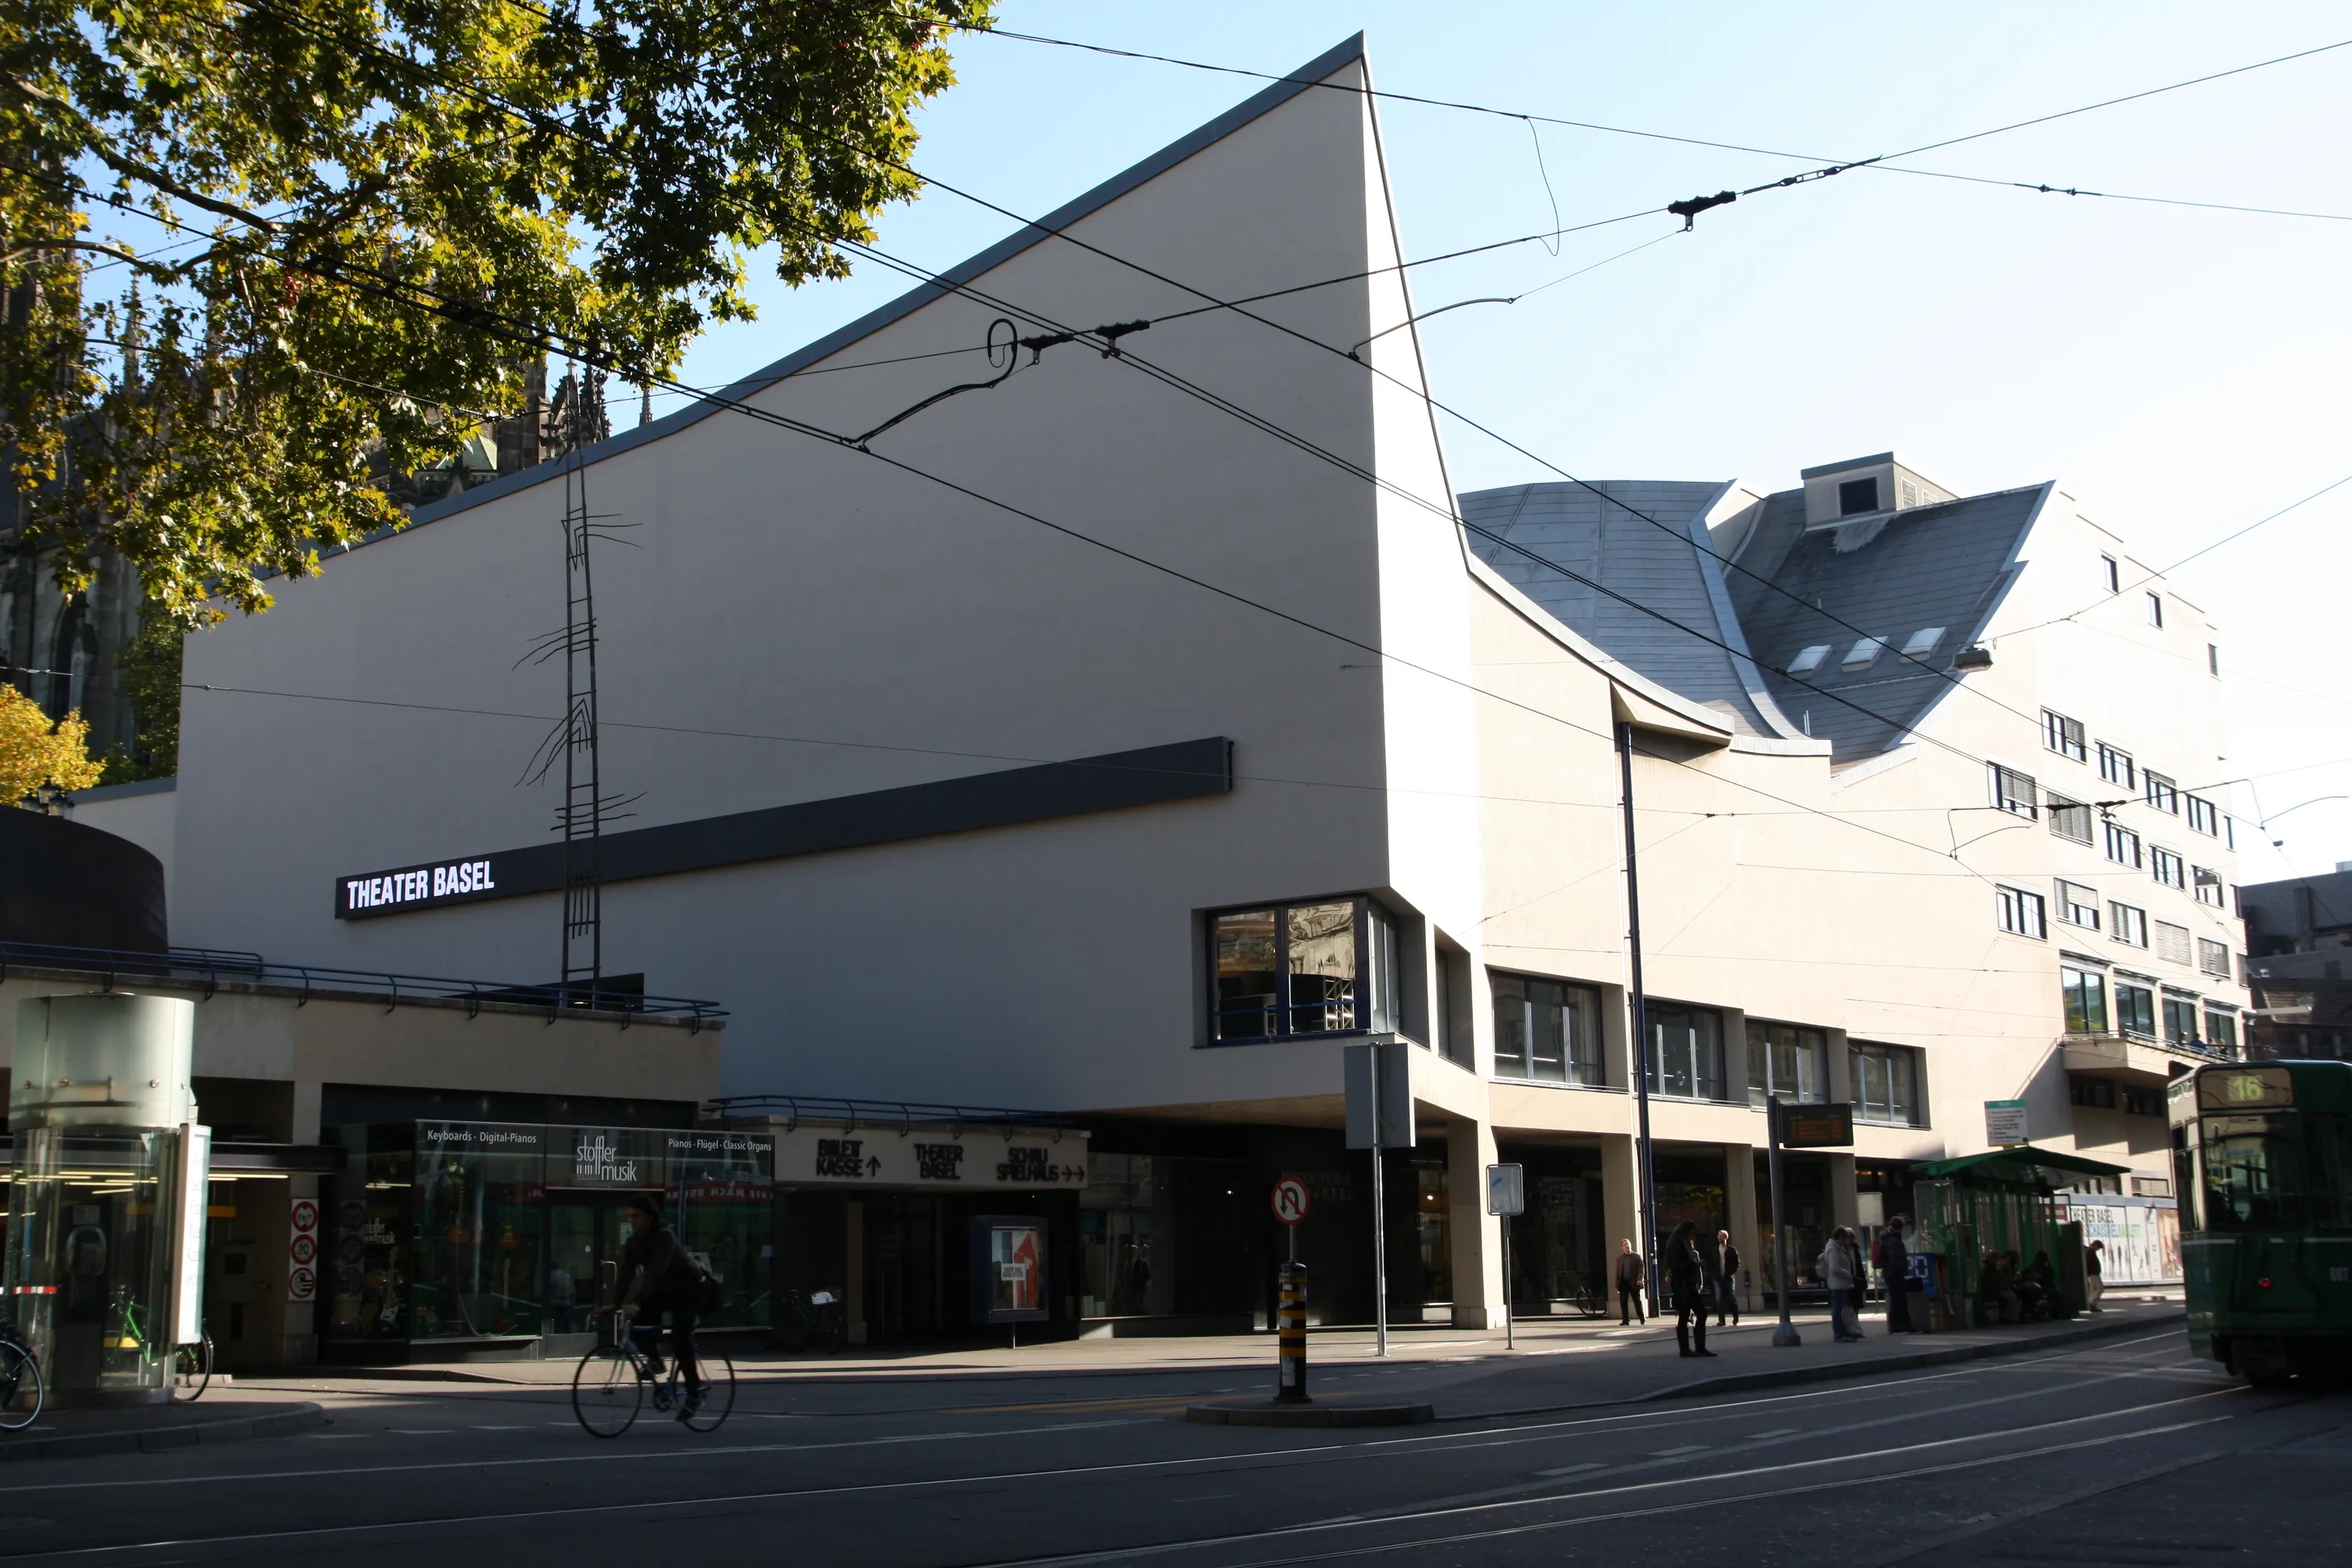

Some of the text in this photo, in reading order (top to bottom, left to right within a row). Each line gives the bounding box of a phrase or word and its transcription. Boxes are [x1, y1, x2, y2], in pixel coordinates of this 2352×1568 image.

[347, 861, 495, 909] THEATER BASEL
[2234, 1076, 2262, 1101] 16
[427, 1129, 537, 1144] Keyboards Digital-Pianos
[669, 1138, 771, 1152] Pianos Flügel Classic Organs
[576, 1135, 617, 1174] stoffler
[913, 1144, 964, 1162] THEATER
[1008, 1147, 1048, 1164] SCHAU
[601, 1160, 637, 1181] musik
[816, 1157, 864, 1178] KASSE
[920, 1160, 961, 1179] BASEL
[996, 1162, 1060, 1181] SPIELHAUS
